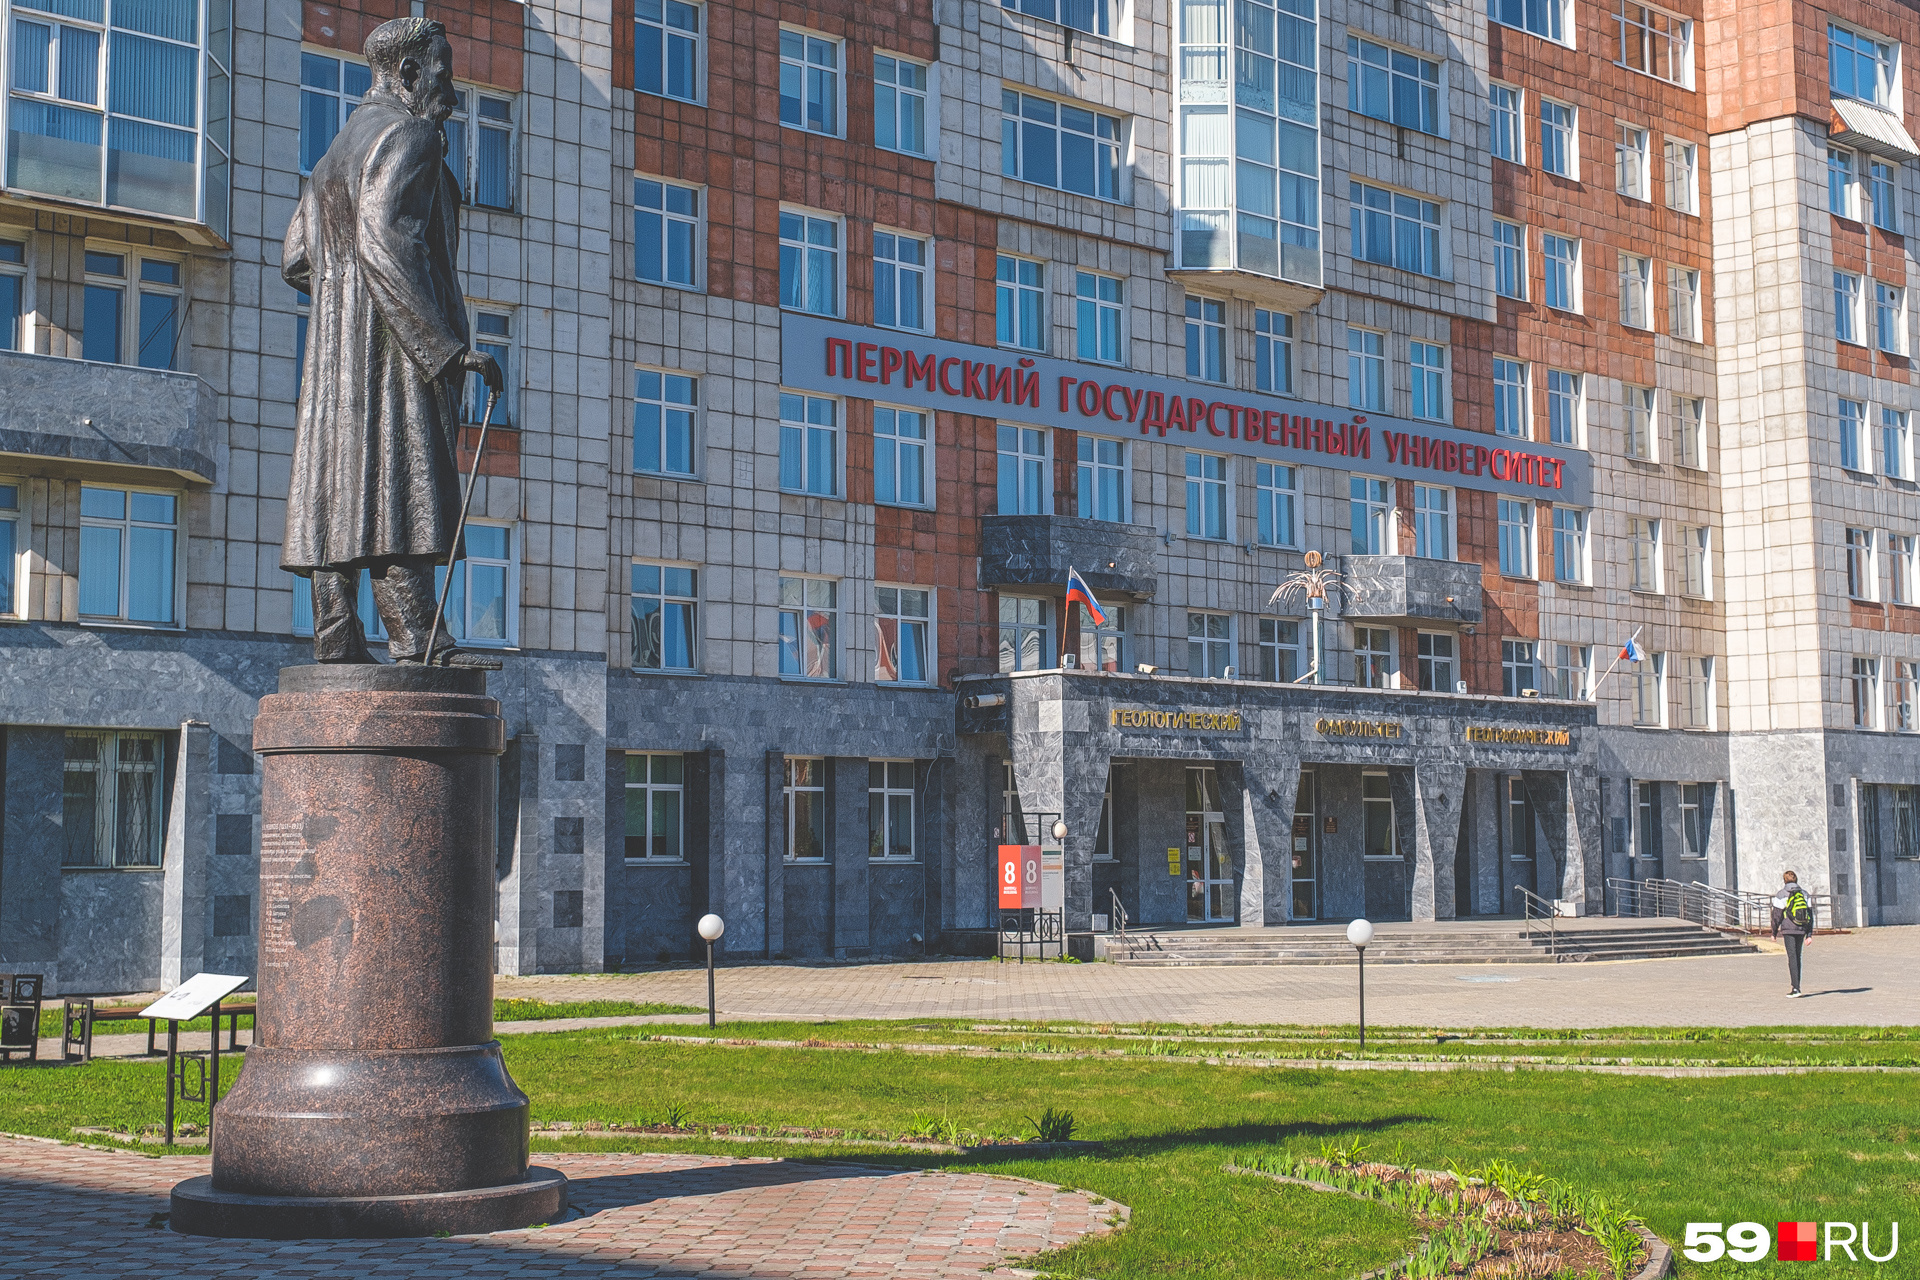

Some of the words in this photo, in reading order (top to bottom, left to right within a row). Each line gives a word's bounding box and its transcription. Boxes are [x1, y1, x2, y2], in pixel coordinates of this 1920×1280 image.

[826, 336, 1040, 408] ПЕРМСКИЙ
[1059, 375, 1371, 460] ГОСУДАРСТВЕННЫЙ
[1384, 429, 1566, 489] УНИВЕРСИТЕТ
[1111, 709, 1242, 731] ГЕОЛОГИЧЕСКИЙ
[1315, 717, 1402, 739] ФАКУЛЬТЕТ
[1466, 725, 1570, 746] ГЕОГРАФИЧЕСКИЙ
[1004, 861, 1016, 884] 8
[1026, 860, 1038, 884] 8
